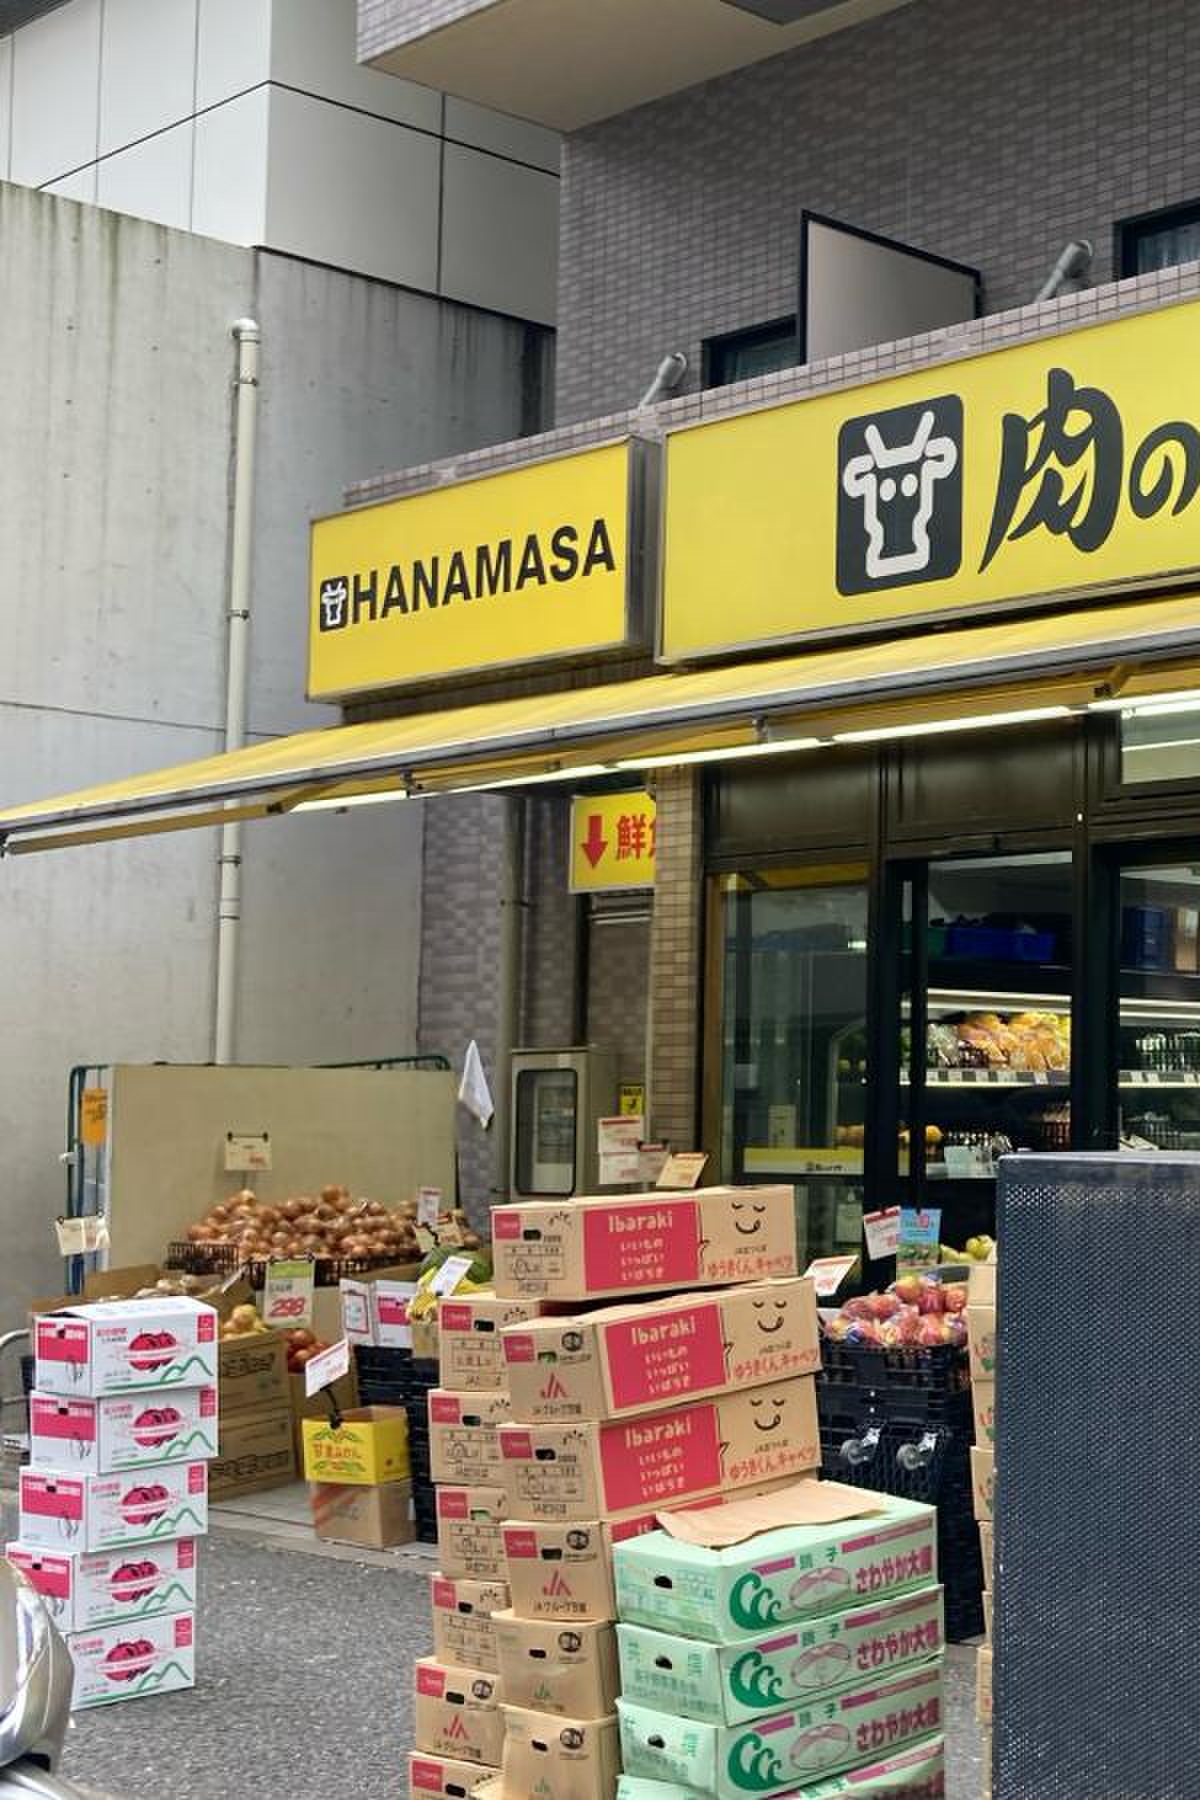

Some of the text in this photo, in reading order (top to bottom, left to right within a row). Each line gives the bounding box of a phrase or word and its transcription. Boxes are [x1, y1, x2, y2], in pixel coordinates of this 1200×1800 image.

[351, 518, 616, 624] HANAMASA
[615, 813, 656, 860] 鮮
[608, 1210, 673, 1233] Ibaraki
[631, 1316, 696, 1345] Ibaraki
[625, 1417, 692, 1449] Ibaraki
